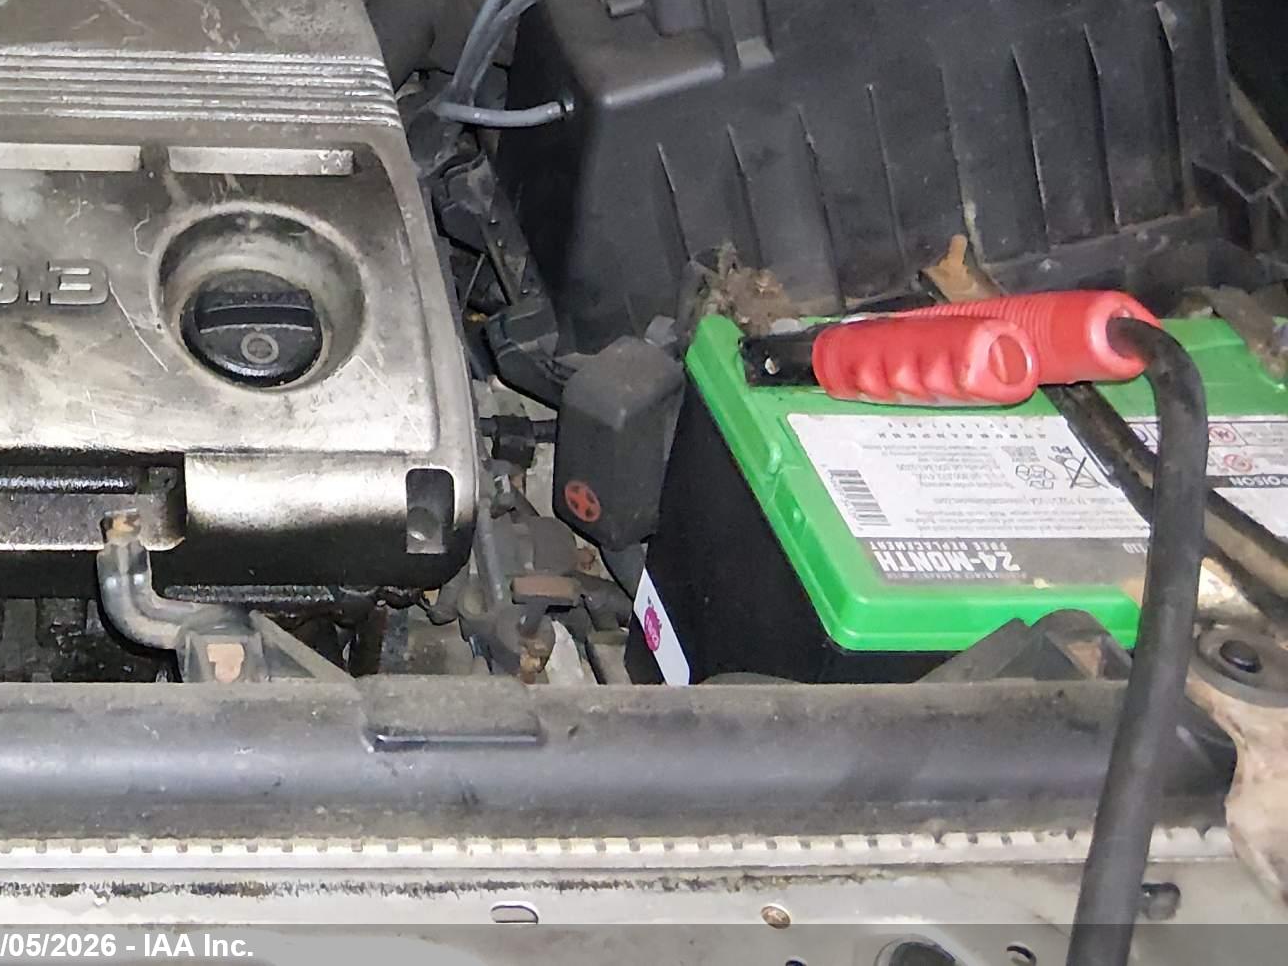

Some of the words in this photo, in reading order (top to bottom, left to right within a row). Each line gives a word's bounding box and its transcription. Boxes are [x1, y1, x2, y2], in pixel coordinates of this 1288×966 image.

[869, 541, 969, 551] REPLACEMENT
[971, 541, 1008, 551] FREE
[872, 550, 1022, 572] 24-MONTH
